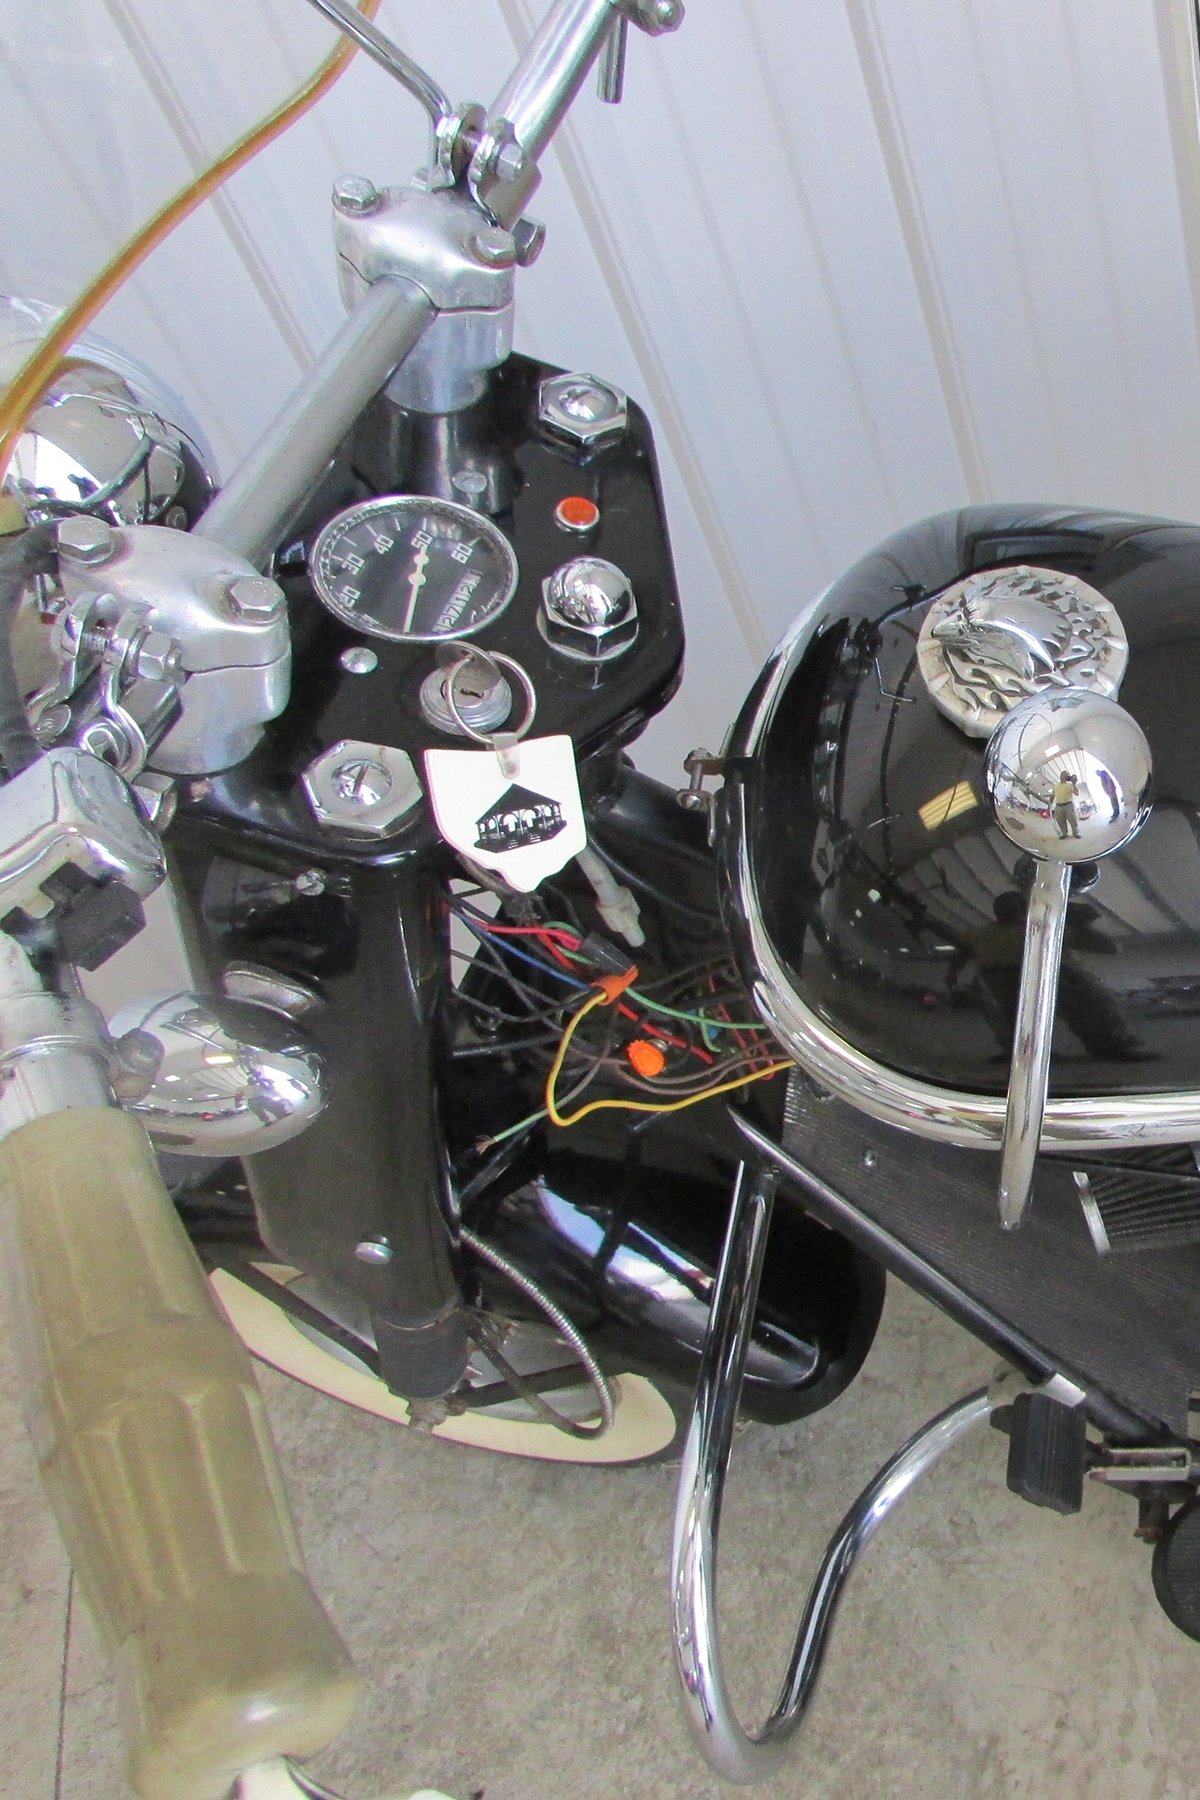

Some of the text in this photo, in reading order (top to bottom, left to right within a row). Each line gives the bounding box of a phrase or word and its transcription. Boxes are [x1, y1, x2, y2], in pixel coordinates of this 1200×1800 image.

[374, 534, 394, 555] 40
[411, 530, 434, 549] 50
[341, 552, 365, 575] 30
[451, 542, 474, 564] 60
